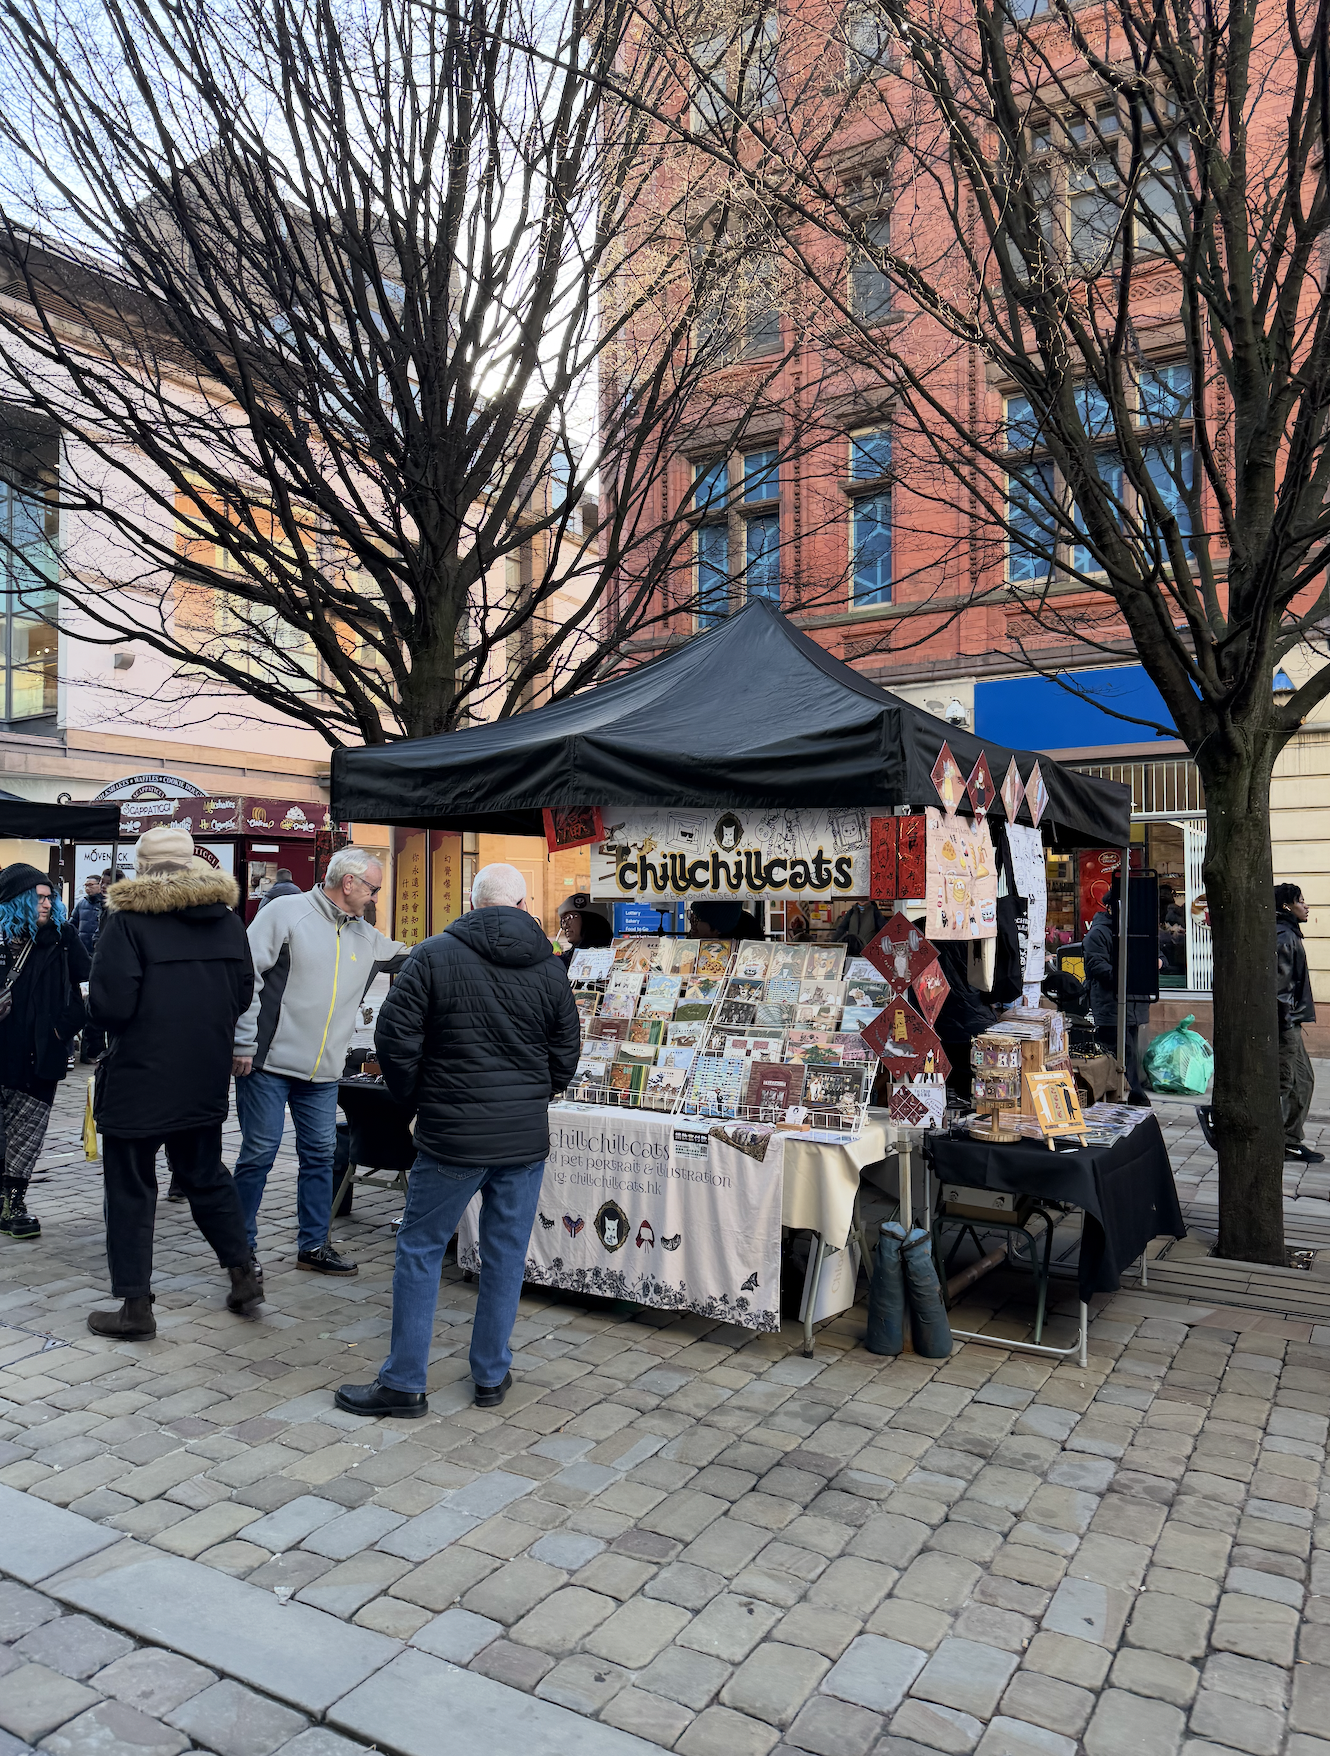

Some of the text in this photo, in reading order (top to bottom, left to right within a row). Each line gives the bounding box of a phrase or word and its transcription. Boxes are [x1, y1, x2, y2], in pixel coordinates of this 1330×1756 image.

[616, 845, 854, 893] chillchillcats
[664, 891, 771, 901] PERSONALISED GIFT
[549, 1128, 670, 1161] chillchillcats
[561, 1153, 583, 1168] pet
[586, 1156, 641, 1173] portrait
[643, 1163, 653, 1176] &
[656, 1166, 732, 1188] illustration
[570, 1171, 662, 1195] chillchillcats.hk
